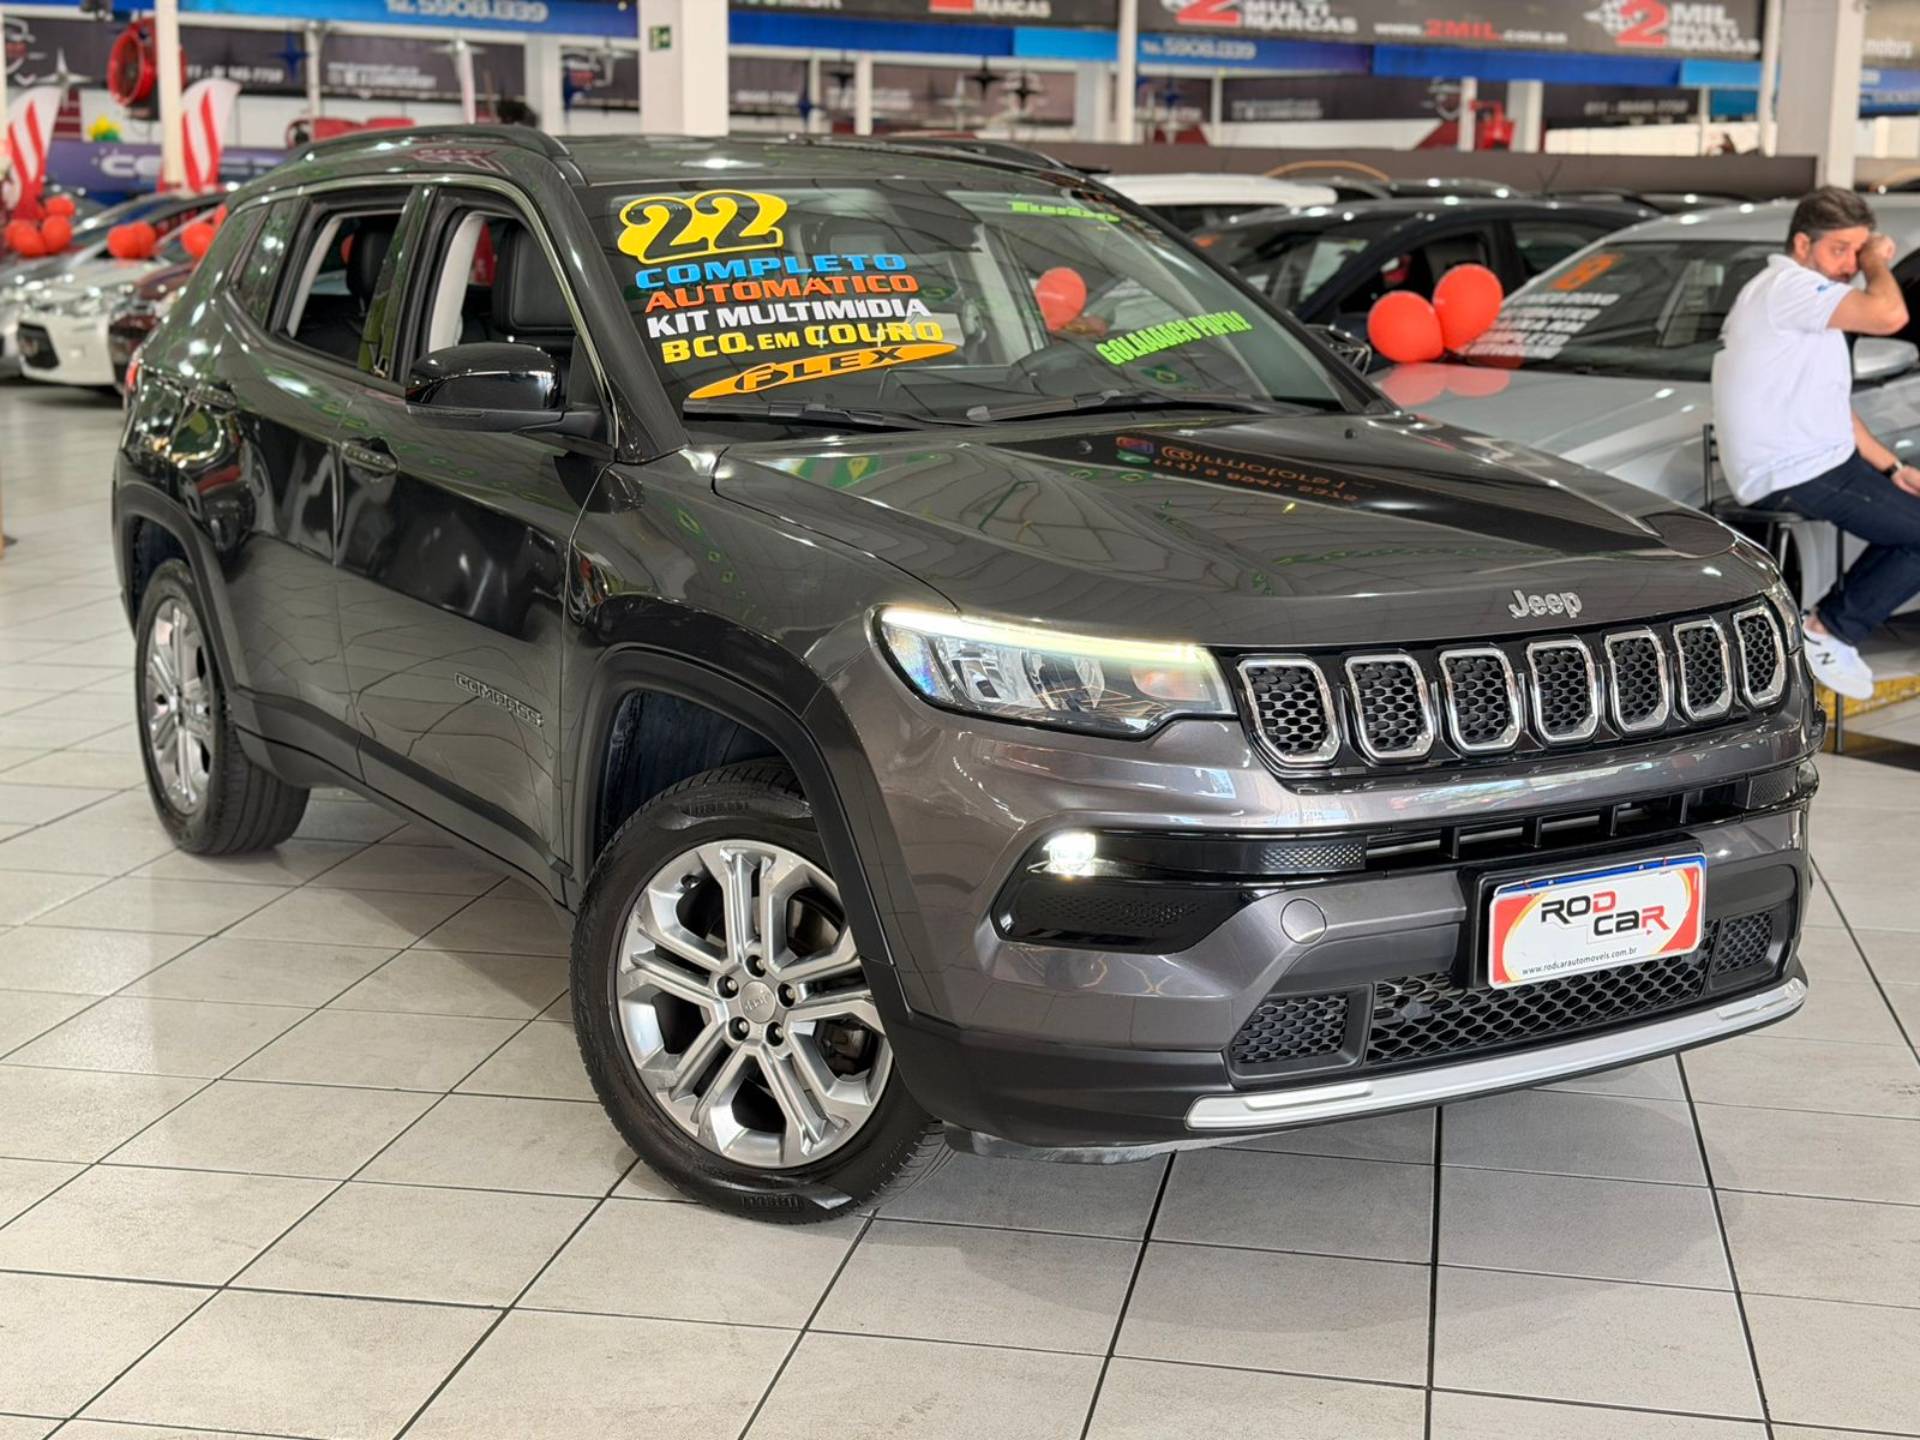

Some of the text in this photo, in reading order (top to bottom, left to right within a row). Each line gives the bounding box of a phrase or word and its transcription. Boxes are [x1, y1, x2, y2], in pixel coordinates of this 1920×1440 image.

[1244, 12, 1358, 33] MARCAS
[1616, 0, 1669, 48] 2
[1673, 3, 1726, 24] MIL
[1671, 19, 1739, 38] MULTI
[1671, 34, 1760, 53] MARCAS
[617, 189, 788, 265] 22
[634, 253, 908, 290] COMPLETO
[646, 310, 710, 338] KIT
[757, 331, 801, 351] EM
[803, 321, 944, 348] COURO
[735, 346, 904, 392] FLEX
[1508, 589, 1583, 618] Jeep
[1541, 890, 1617, 925] ROD
